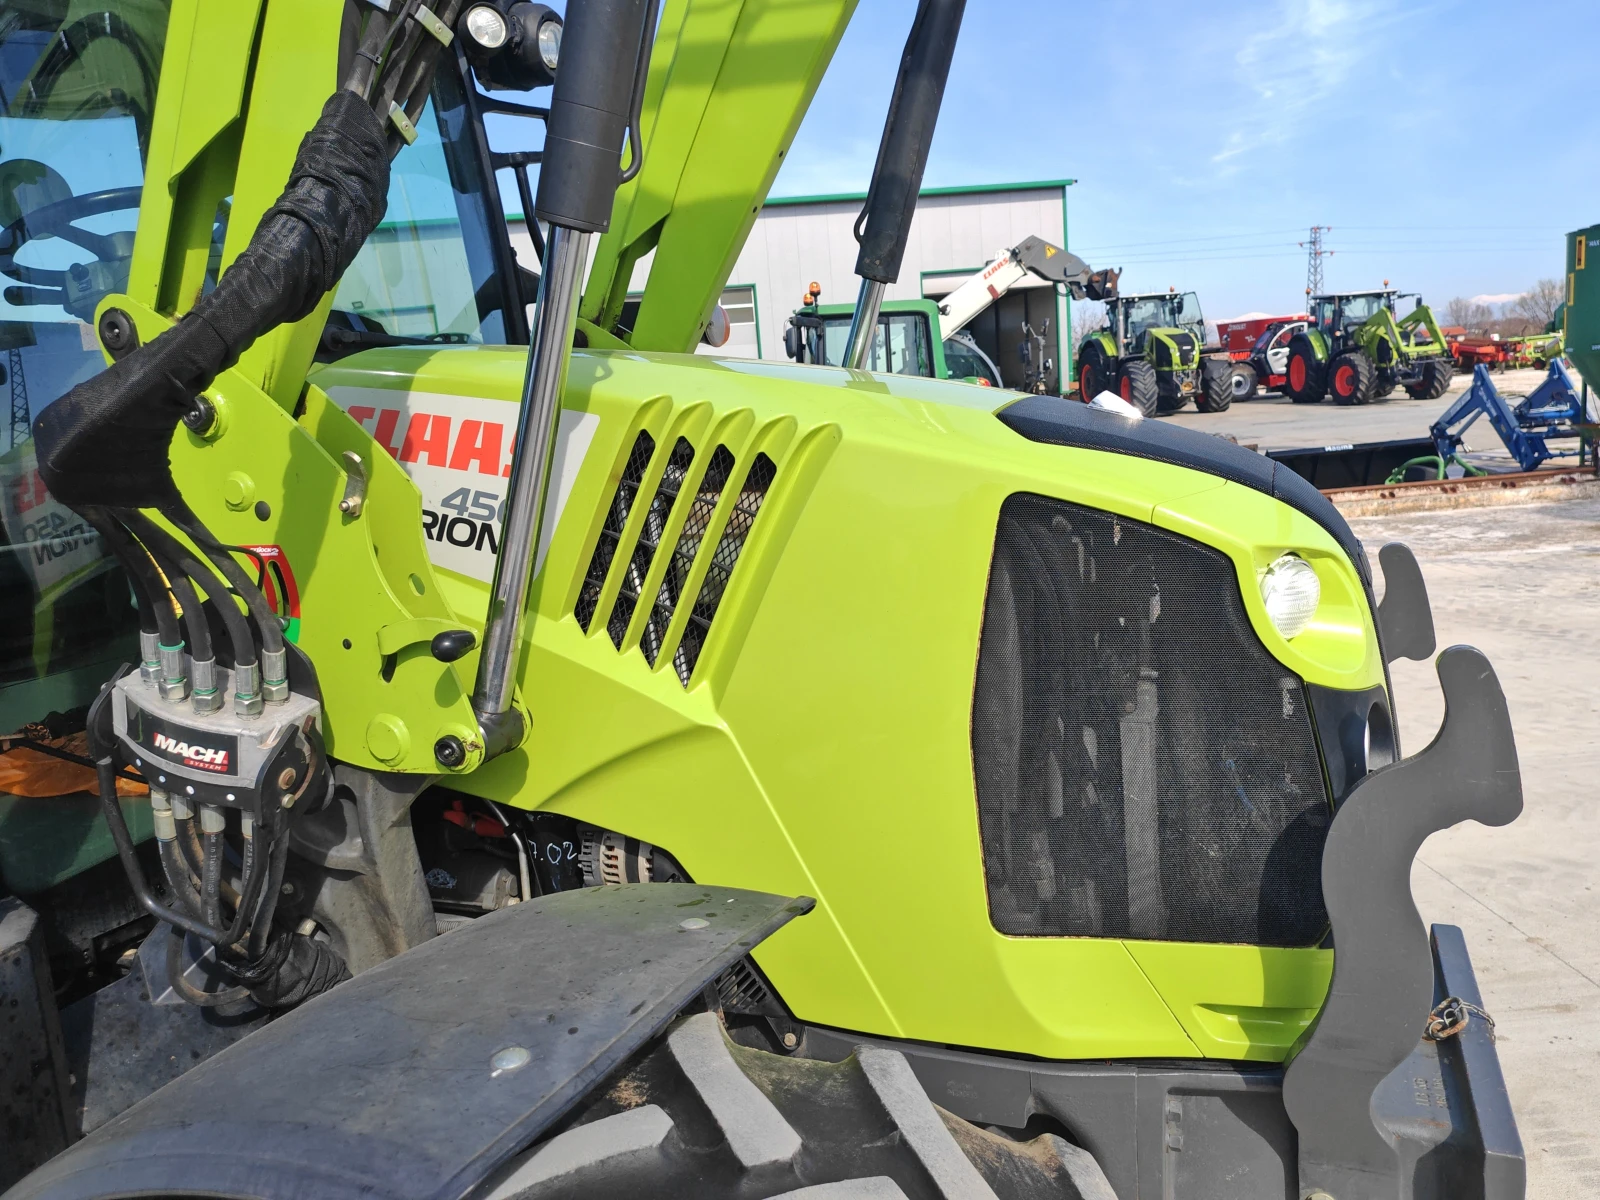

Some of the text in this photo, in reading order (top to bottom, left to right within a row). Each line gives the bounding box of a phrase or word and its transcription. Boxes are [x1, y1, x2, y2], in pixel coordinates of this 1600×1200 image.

[983, 257, 1009, 280] CLAAS
[422, 509, 498, 555] RION
[154, 733, 227, 764] MACH
[189, 760, 222, 771] SYSTEM
